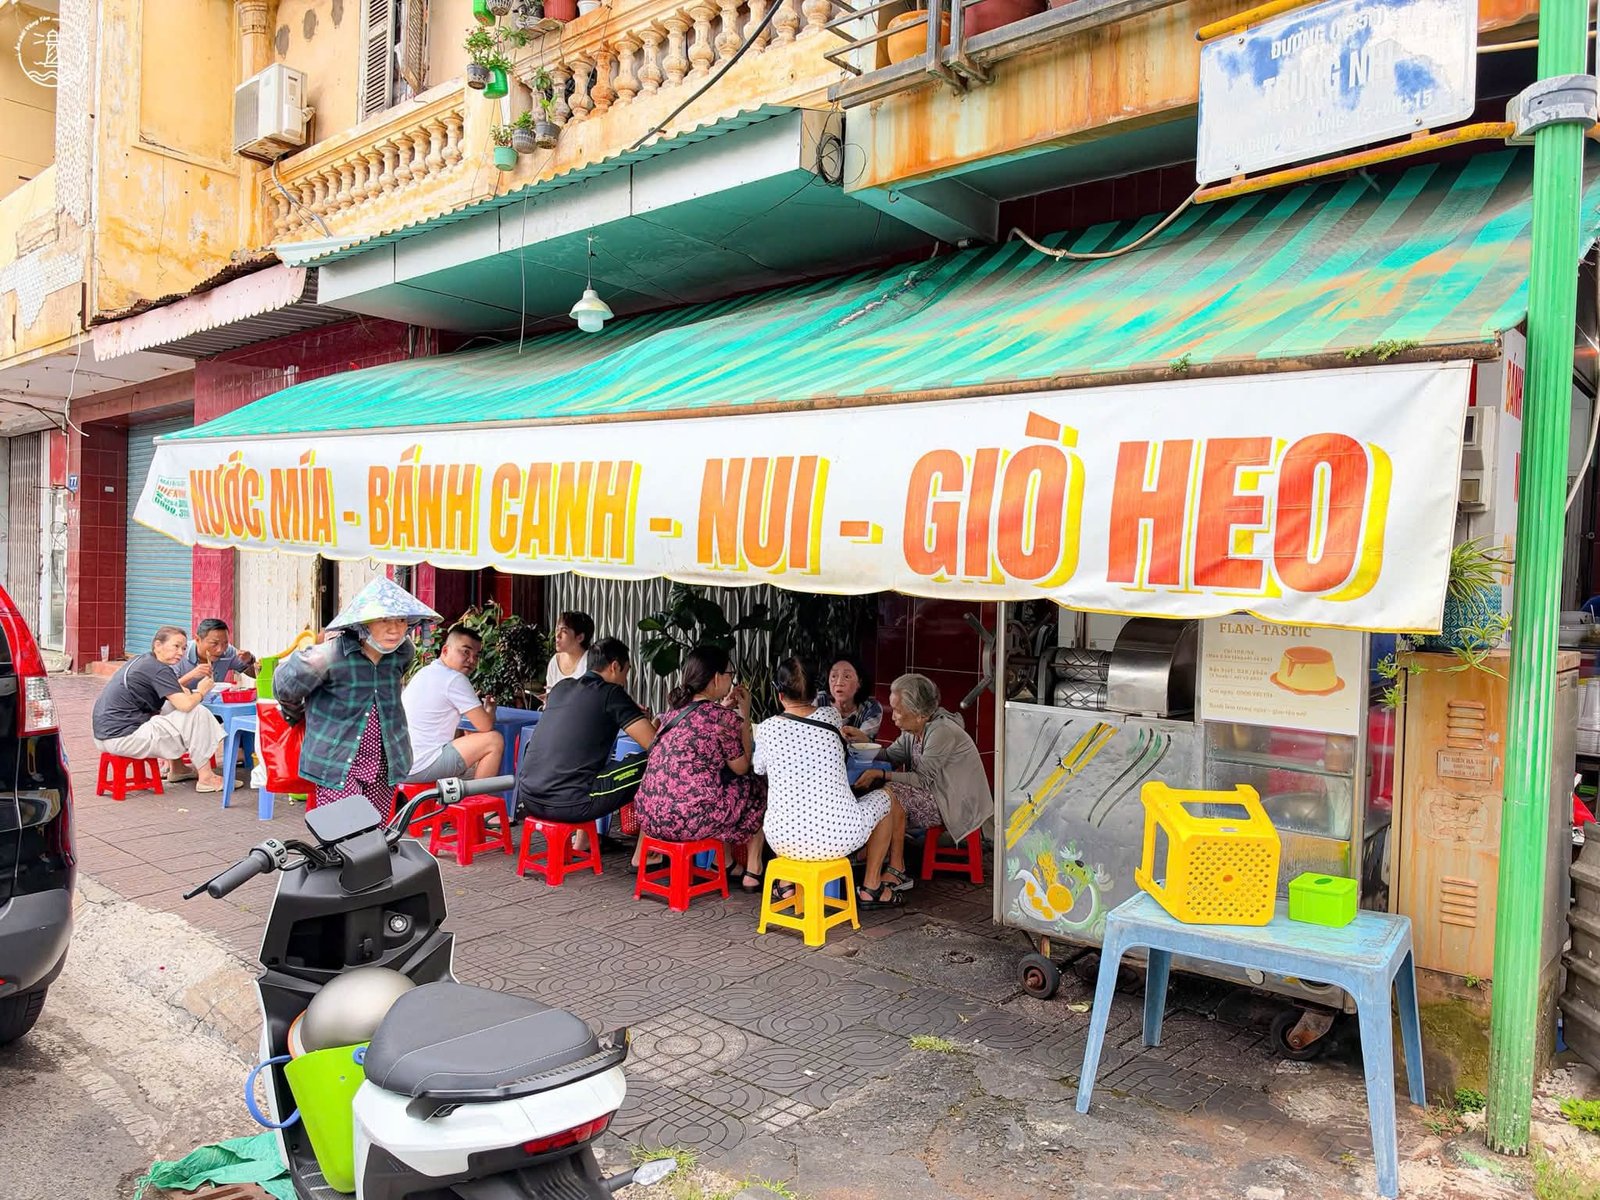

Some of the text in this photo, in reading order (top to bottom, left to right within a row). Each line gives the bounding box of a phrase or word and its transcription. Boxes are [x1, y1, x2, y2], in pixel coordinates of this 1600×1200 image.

[189, 450, 266, 541] NƯỚC
[271, 448, 338, 545] MÍA
[368, 443, 480, 557] BÁNH
[490, 460, 642, 566] CANH
[697, 455, 830, 575] NUI
[903, 410, 1086, 589] GIÒ
[1106, 432, 1394, 603] HEO
[1219, 622, 1312, 638] FLAN-TASTIC
